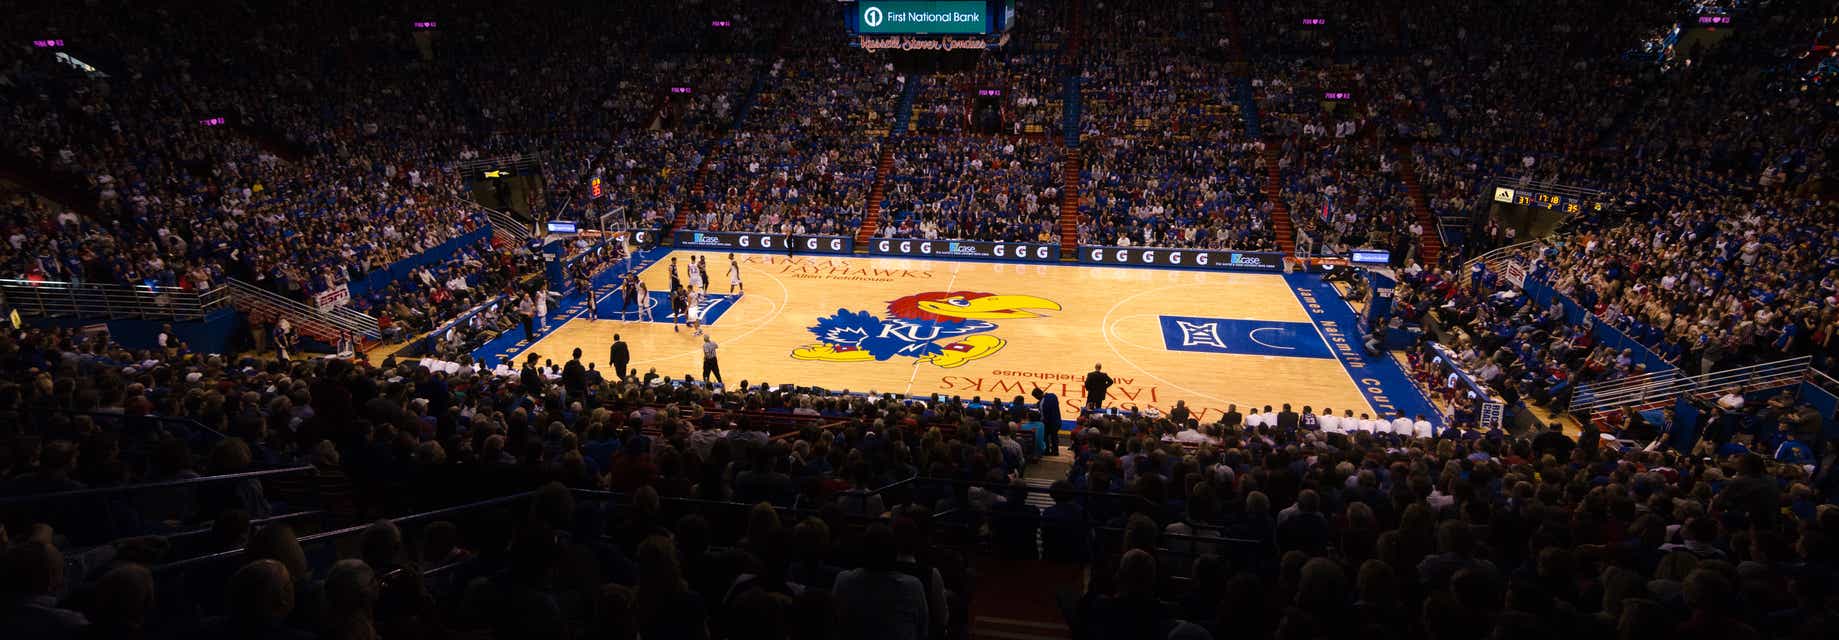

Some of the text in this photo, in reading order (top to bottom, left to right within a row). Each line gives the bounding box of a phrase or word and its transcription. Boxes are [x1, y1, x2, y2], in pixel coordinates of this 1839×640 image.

[888, 11, 980, 22] First National Bank
[860, 35, 900, 53] Russell
[902, 36, 942, 51] Stover
[780, 265, 933, 279] JAYHAWKS
[825, 274, 894, 282] Fieldhouse
[1297, 287, 1325, 315] James
[876, 323, 944, 341] KU
[1320, 320, 1367, 368] Naismith
[992, 370, 1085, 385] Fieldhouse
[1361, 378, 1397, 416] Court
